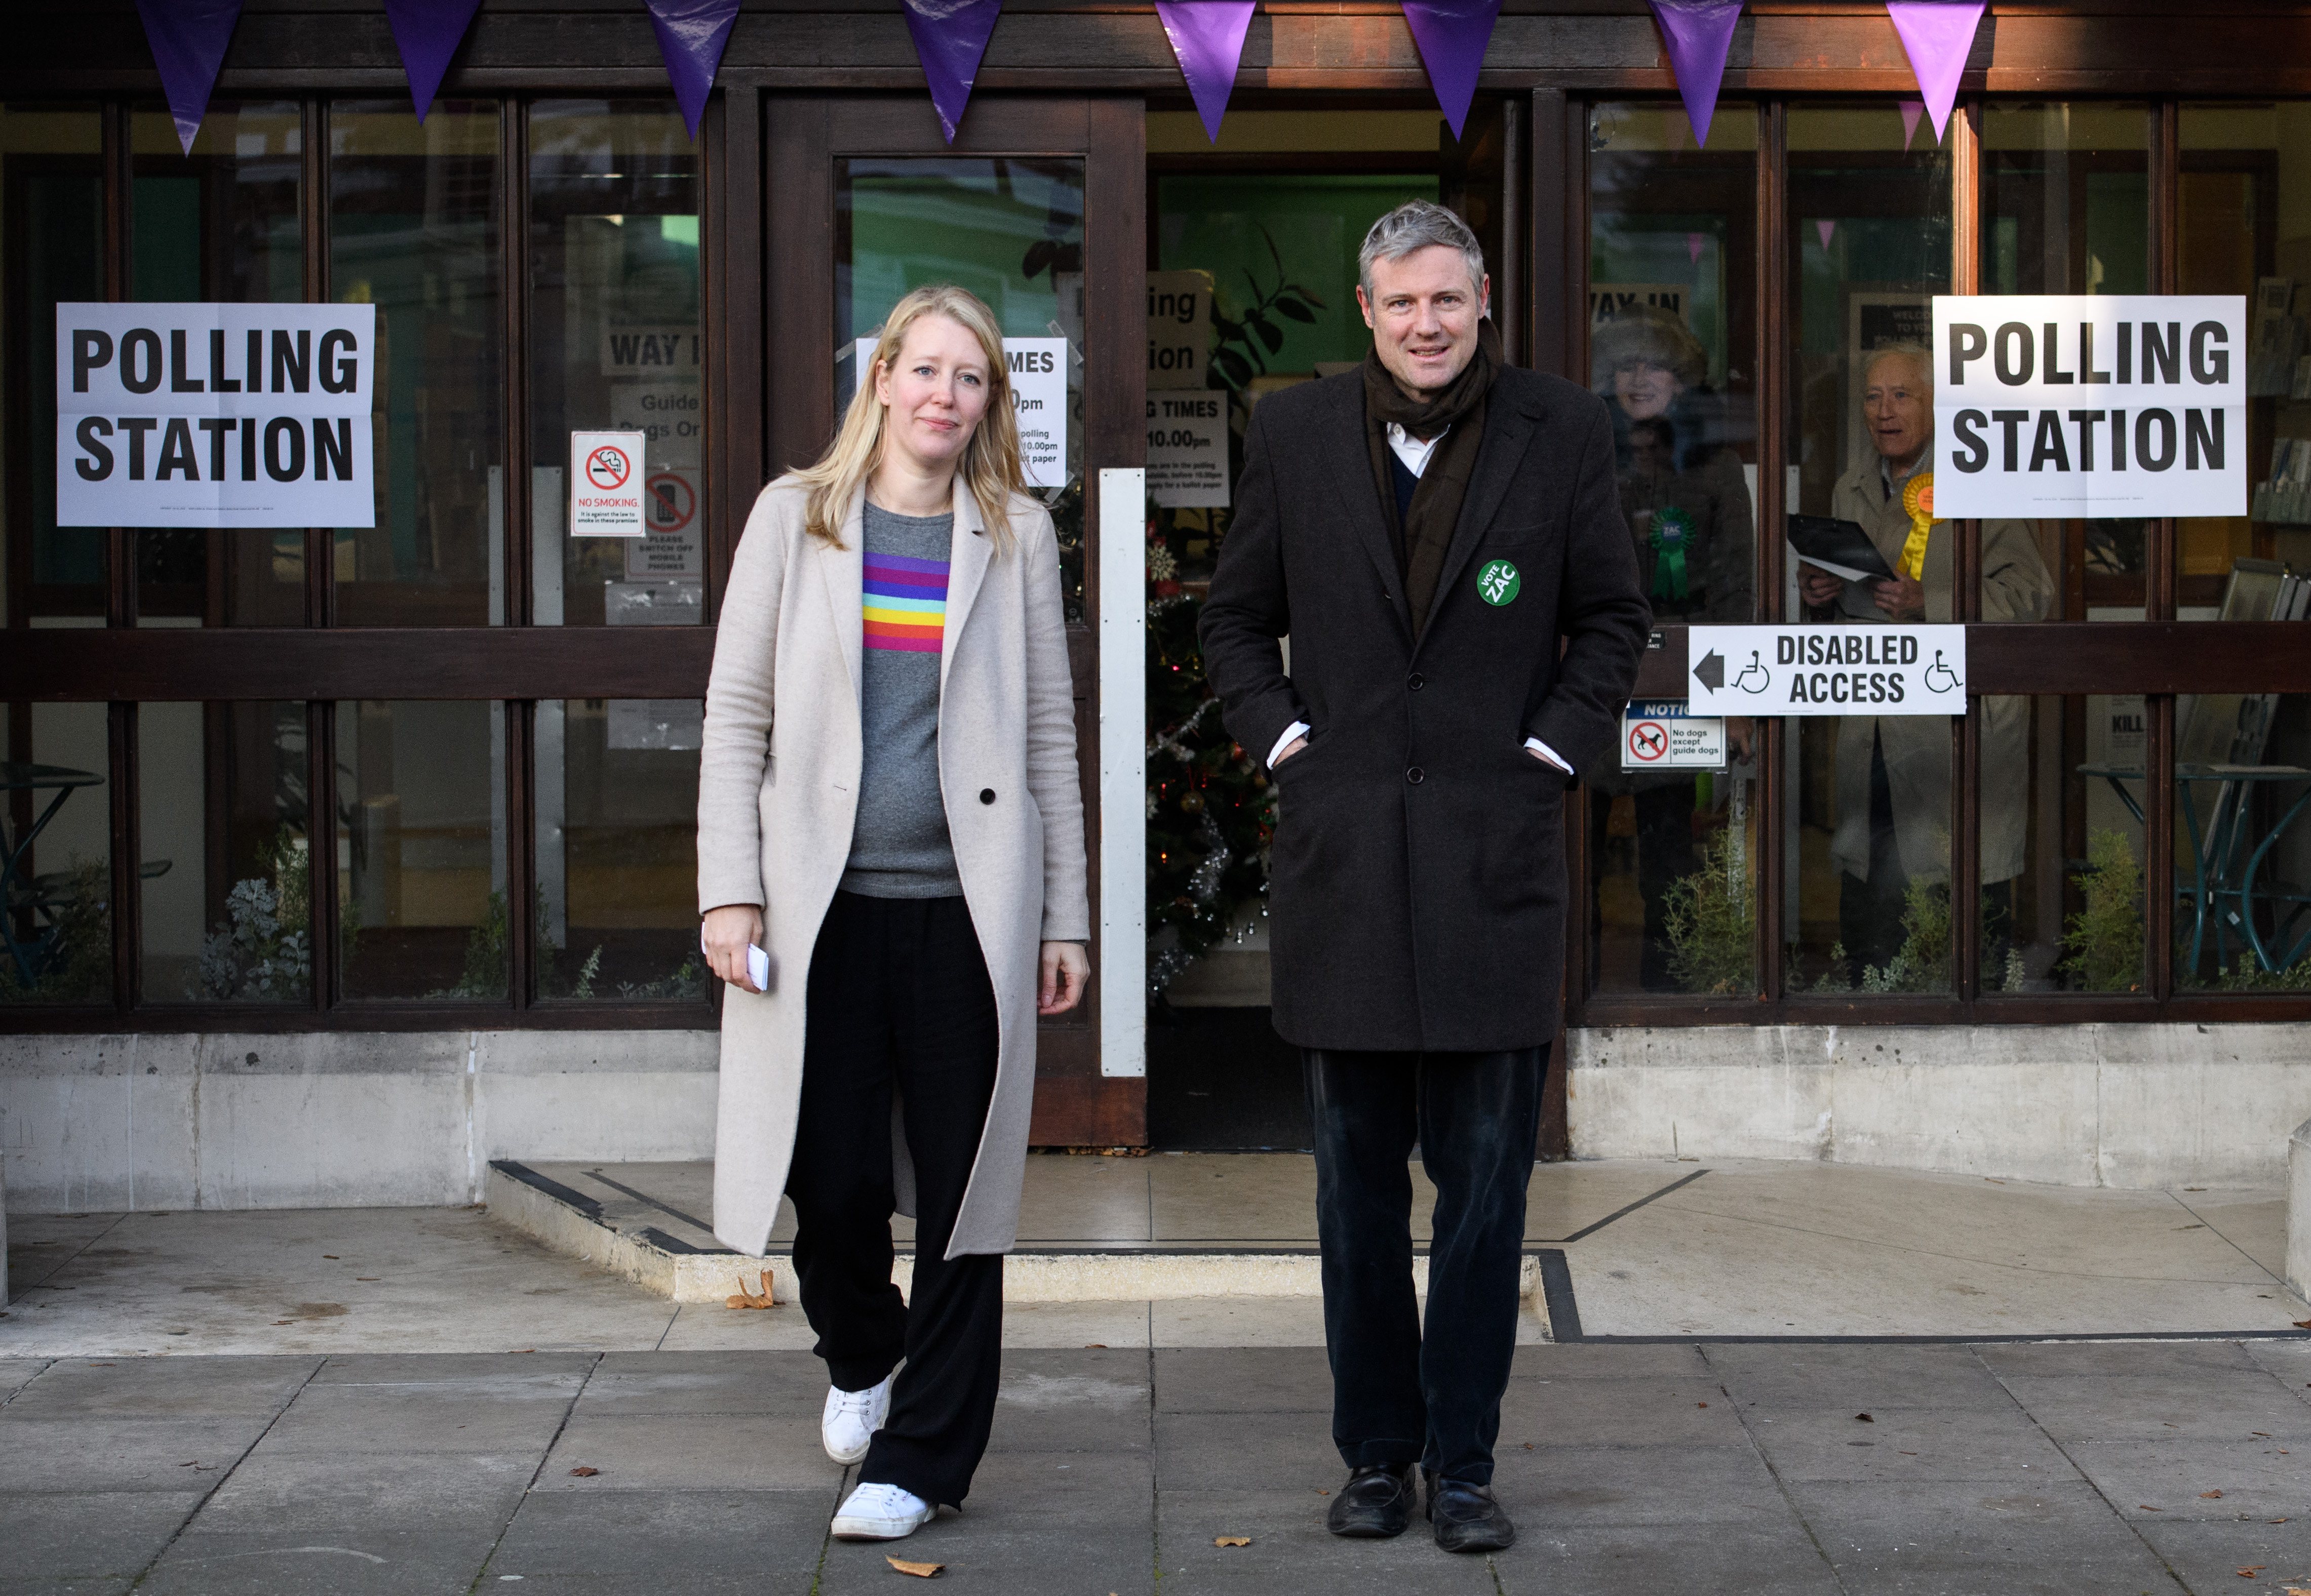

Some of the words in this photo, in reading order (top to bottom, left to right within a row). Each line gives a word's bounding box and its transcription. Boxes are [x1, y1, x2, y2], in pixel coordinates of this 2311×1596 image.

[610, 335, 680, 365] WAY
[1949, 321, 2230, 386] POLLING
[72, 328, 358, 394] POLLING
[641, 394, 699, 411] Guide
[1163, 401, 1218, 418] TIMES
[1021, 429, 1049, 440] polling
[1952, 407, 2225, 474] STATION
[75, 416, 353, 483] STATION
[1023, 442, 1057, 452] 10.00pm
[1032, 456, 1056, 464] paper
[578, 498, 592, 507] NO
[594, 498, 639, 507] SMOKING.
[1481, 565, 1499, 586] VOTE
[1485, 565, 1515, 603] ZAC
[1777, 635, 1917, 665] DISABLED
[1789, 672, 1904, 703] ACCESS
[2112, 715, 2145, 732] KILL
[1687, 730, 1707, 739] dogs
[1673, 747, 1696, 755] guide
[1698, 747, 1718, 755] dogs
